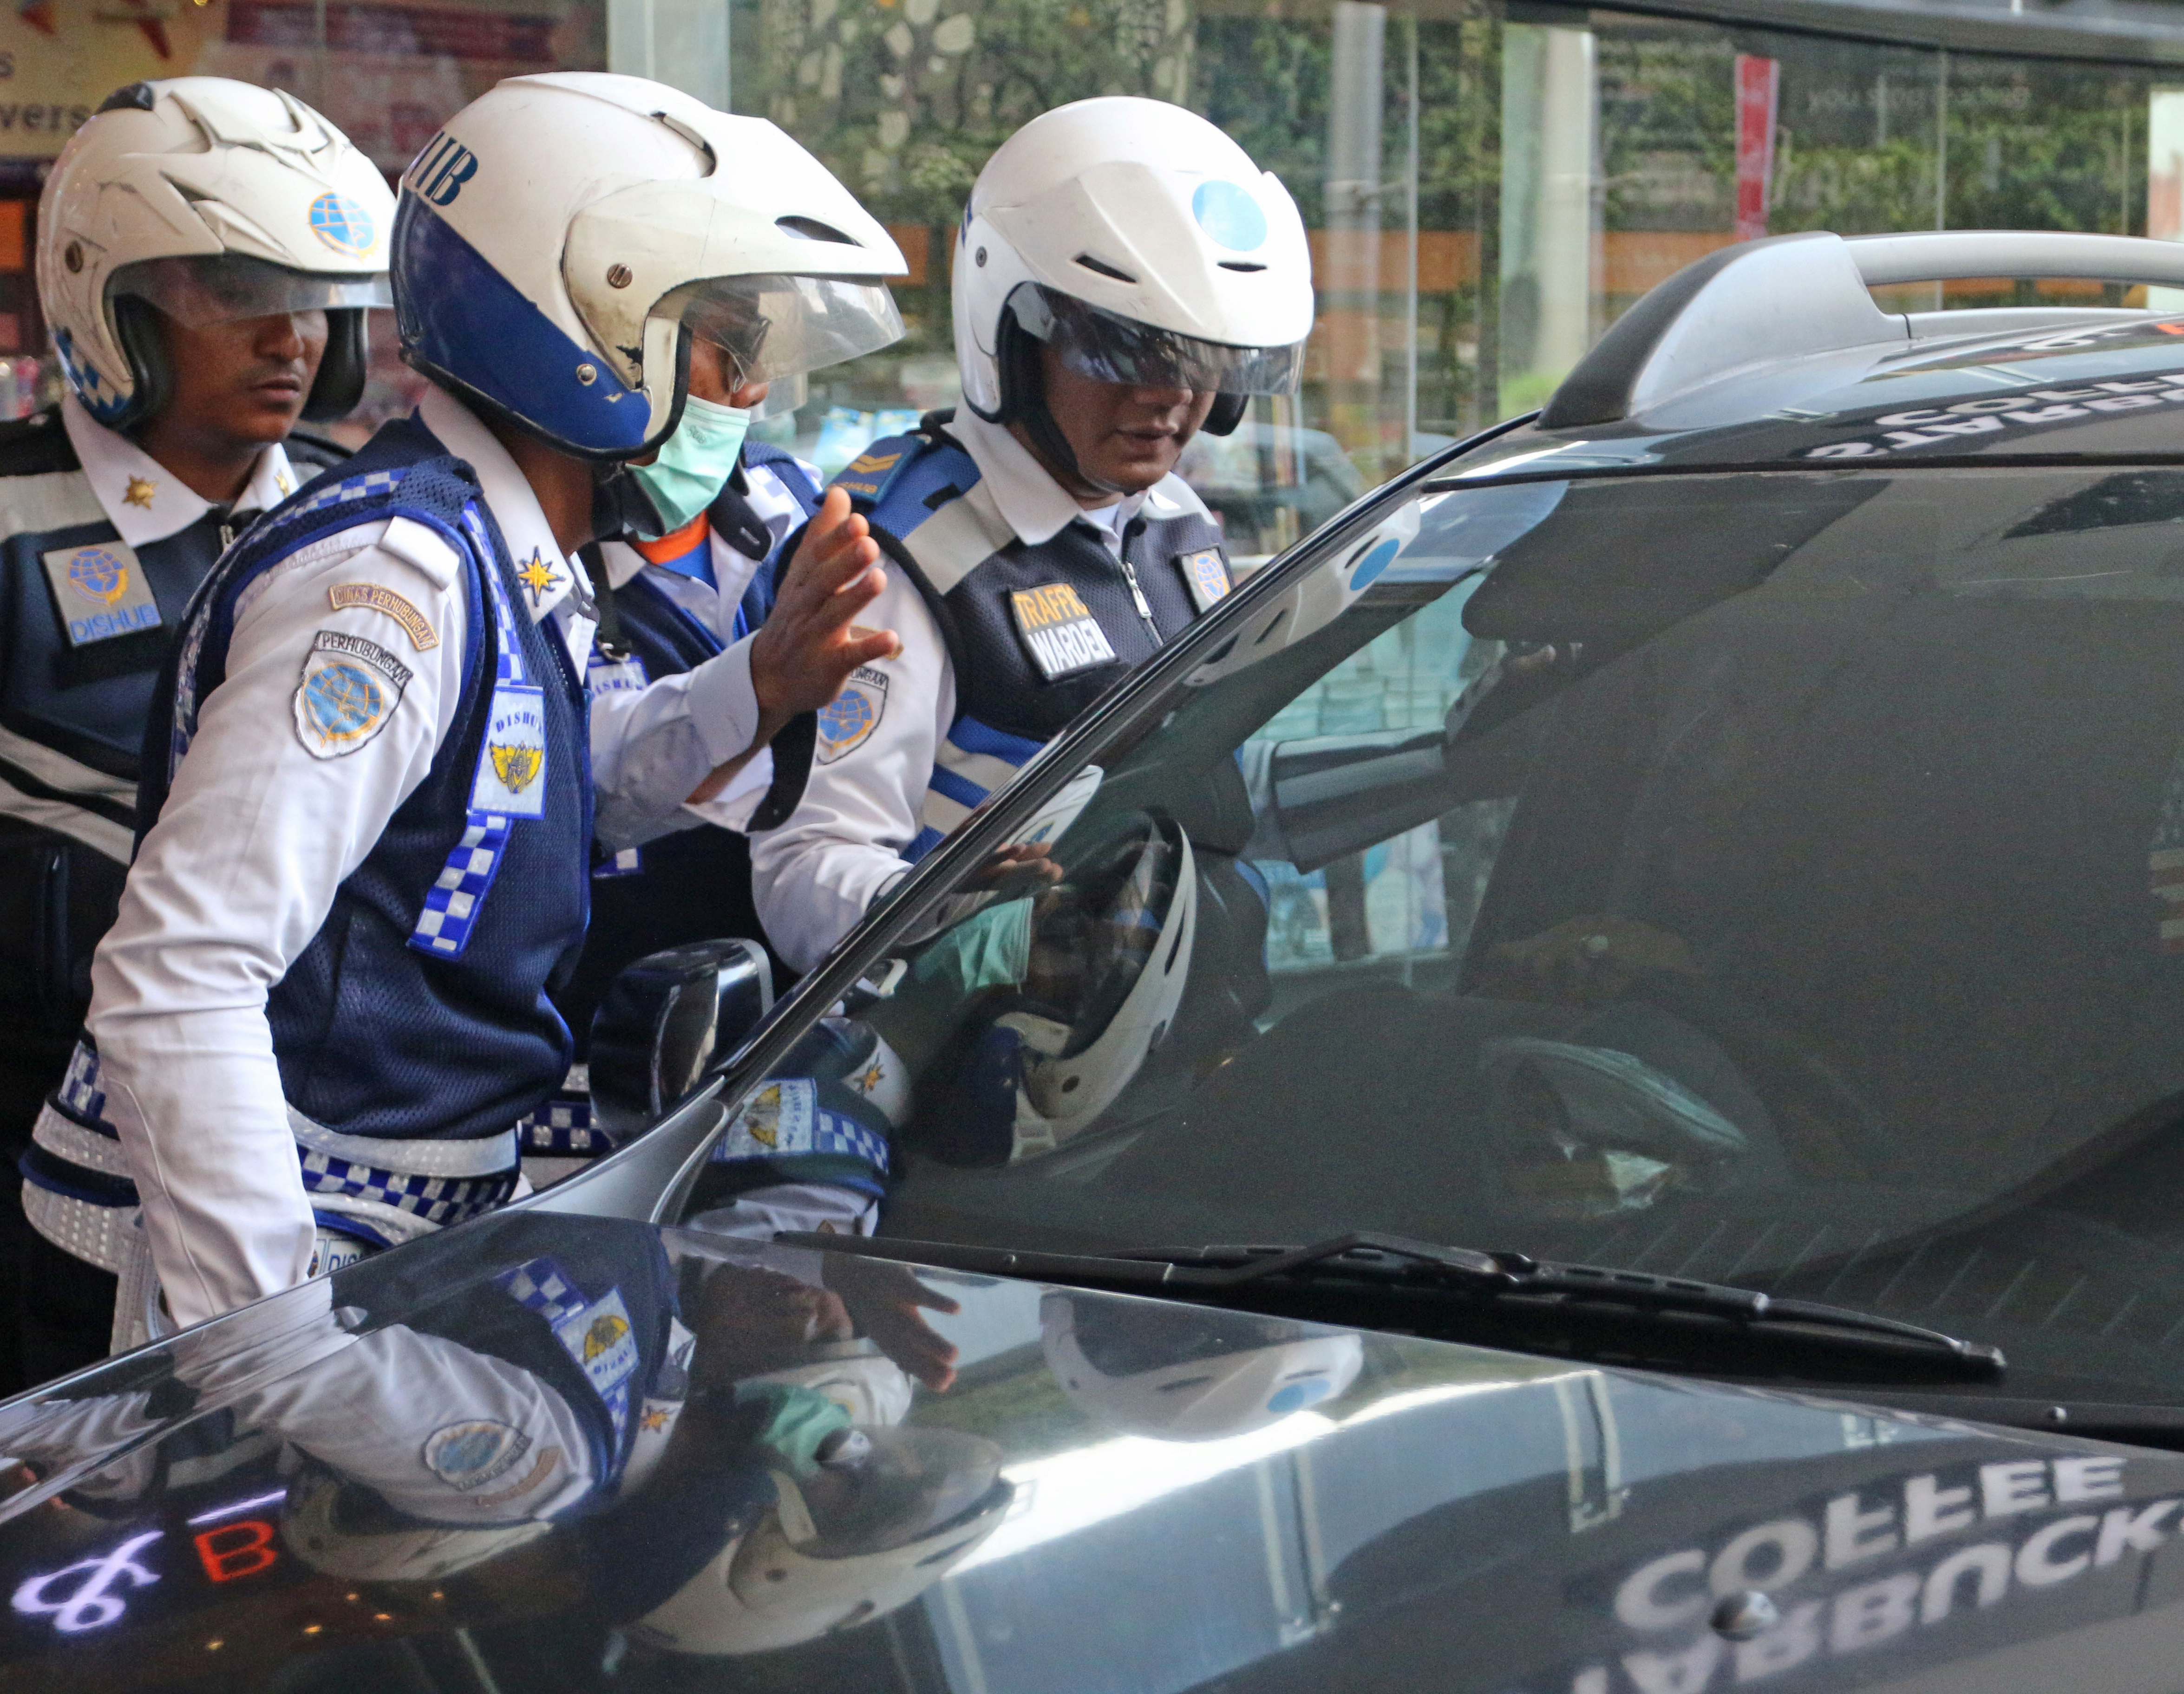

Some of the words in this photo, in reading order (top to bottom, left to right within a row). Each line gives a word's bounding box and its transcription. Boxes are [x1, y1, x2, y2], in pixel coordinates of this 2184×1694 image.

[70, 604, 162, 642] DISHUB
[335, 588, 368, 603] DINAS
[371, 589, 433, 644] PERHUBUNGAN
[322, 632, 410, 682] PERHUBUNGAN
[1027, 618, 1115, 674] WARDEN
